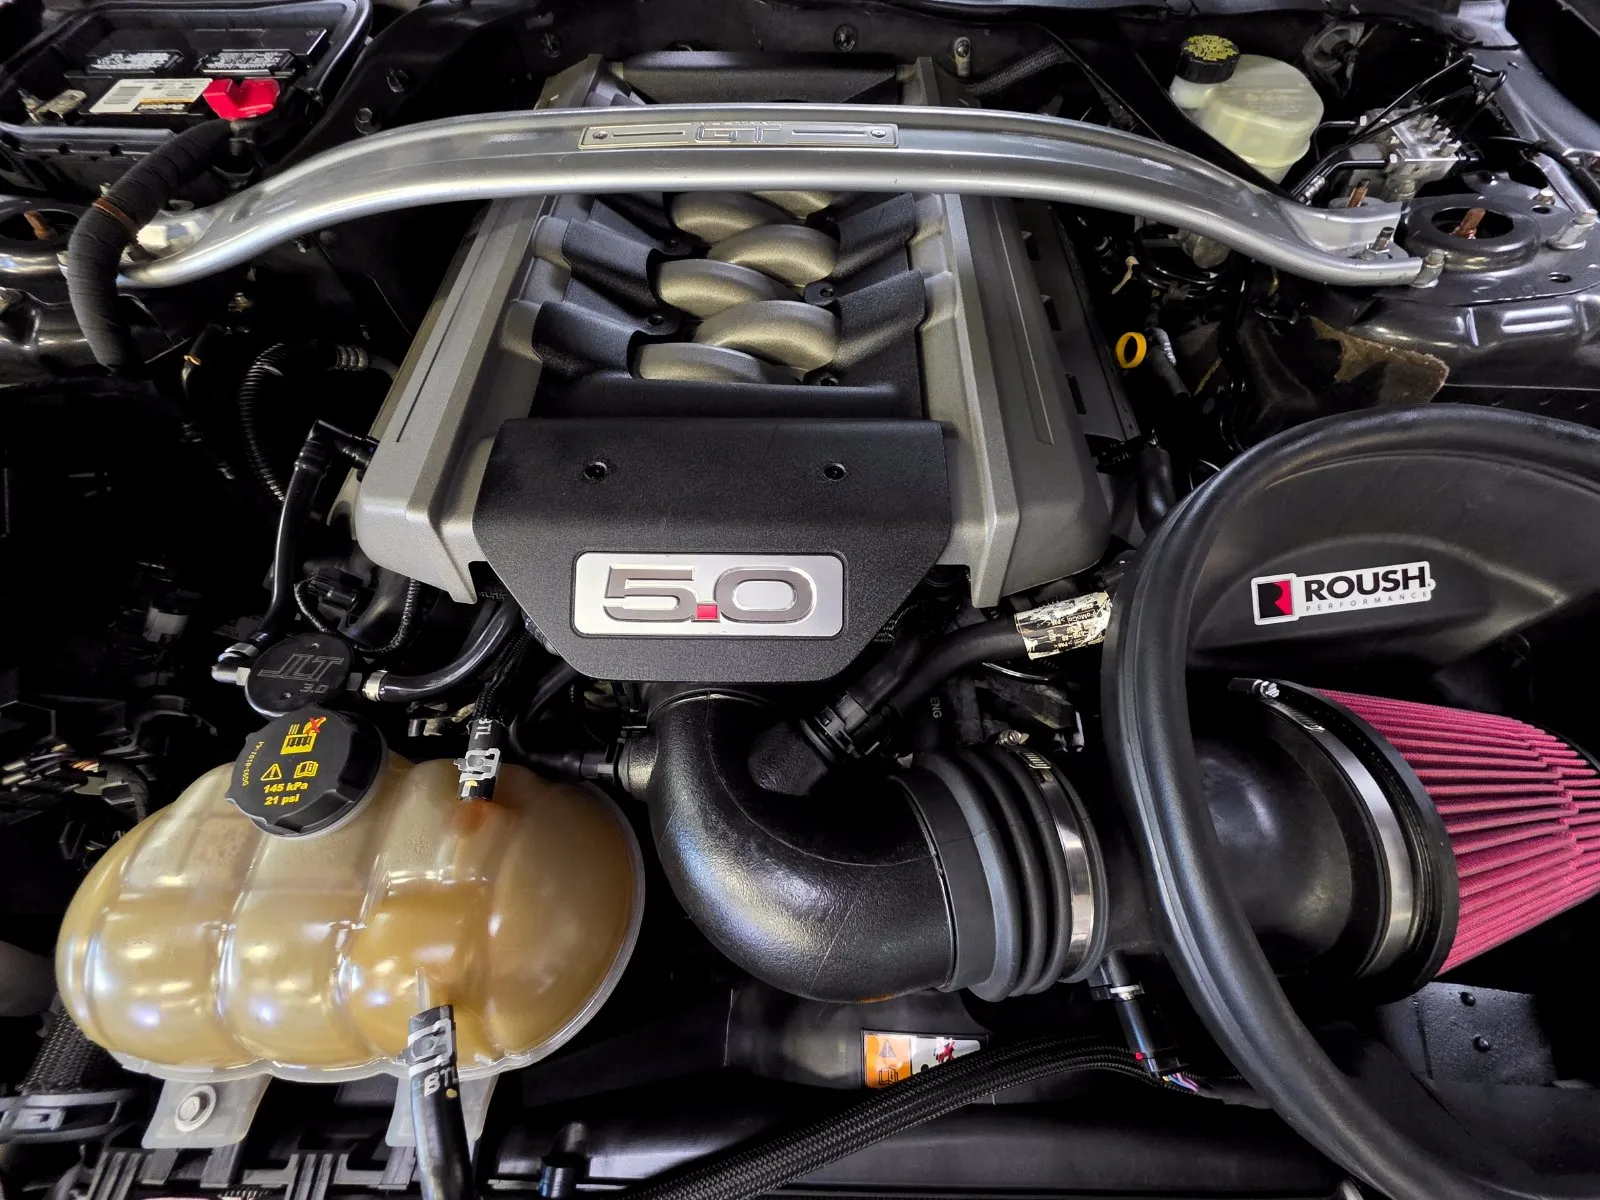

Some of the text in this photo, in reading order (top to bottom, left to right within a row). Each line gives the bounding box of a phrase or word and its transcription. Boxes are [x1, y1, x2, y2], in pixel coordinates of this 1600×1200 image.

[694, 122, 782, 144] GT
[602, 563, 818, 625] 5.0
[1304, 566, 1426, 602] ROUSH
[1304, 591, 1430, 612] PERFORMANCE
[257, 654, 344, 681] JLT
[299, 682, 329, 695] 3.0
[929, 697, 942, 719] ENG
[263, 781, 309, 794] 145 kPa
[263, 793, 301, 806] 21 psi
